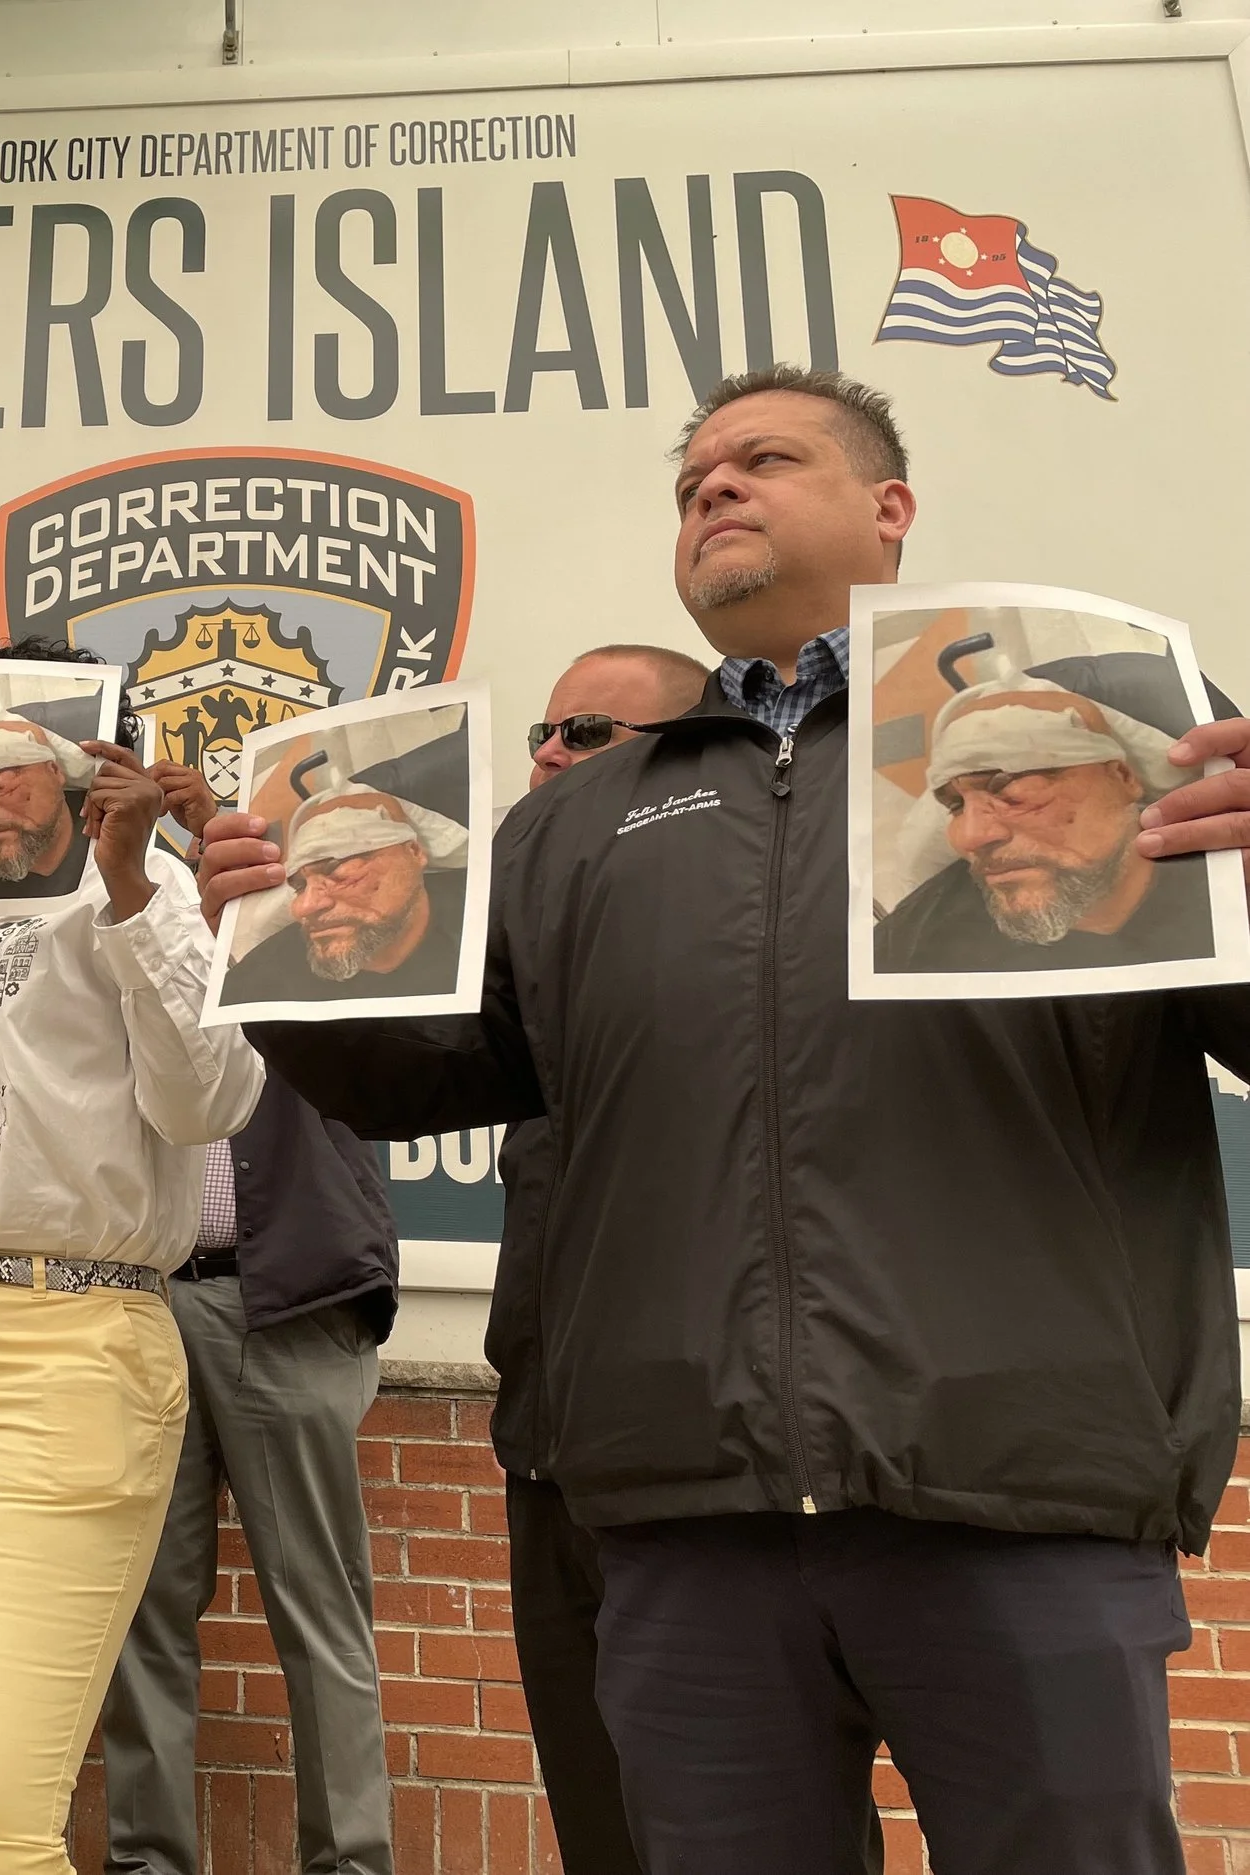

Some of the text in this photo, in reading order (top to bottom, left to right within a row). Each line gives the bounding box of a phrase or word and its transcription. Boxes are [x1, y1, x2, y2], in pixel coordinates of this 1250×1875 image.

[67, 135, 131, 180] CITY
[140, 126, 332, 178] DEPARTMENT
[344, 122, 381, 169] OF
[389, 114, 577, 167] CORRECTION
[267, 170, 839, 422] ISLAND
[28, 477, 437, 565] CORRECTION
[24, 531, 438, 618] DEPARTMENT
[386, 626, 437, 694] RK
[616, 799, 721, 835] SERGEANT-AT-ARMS
